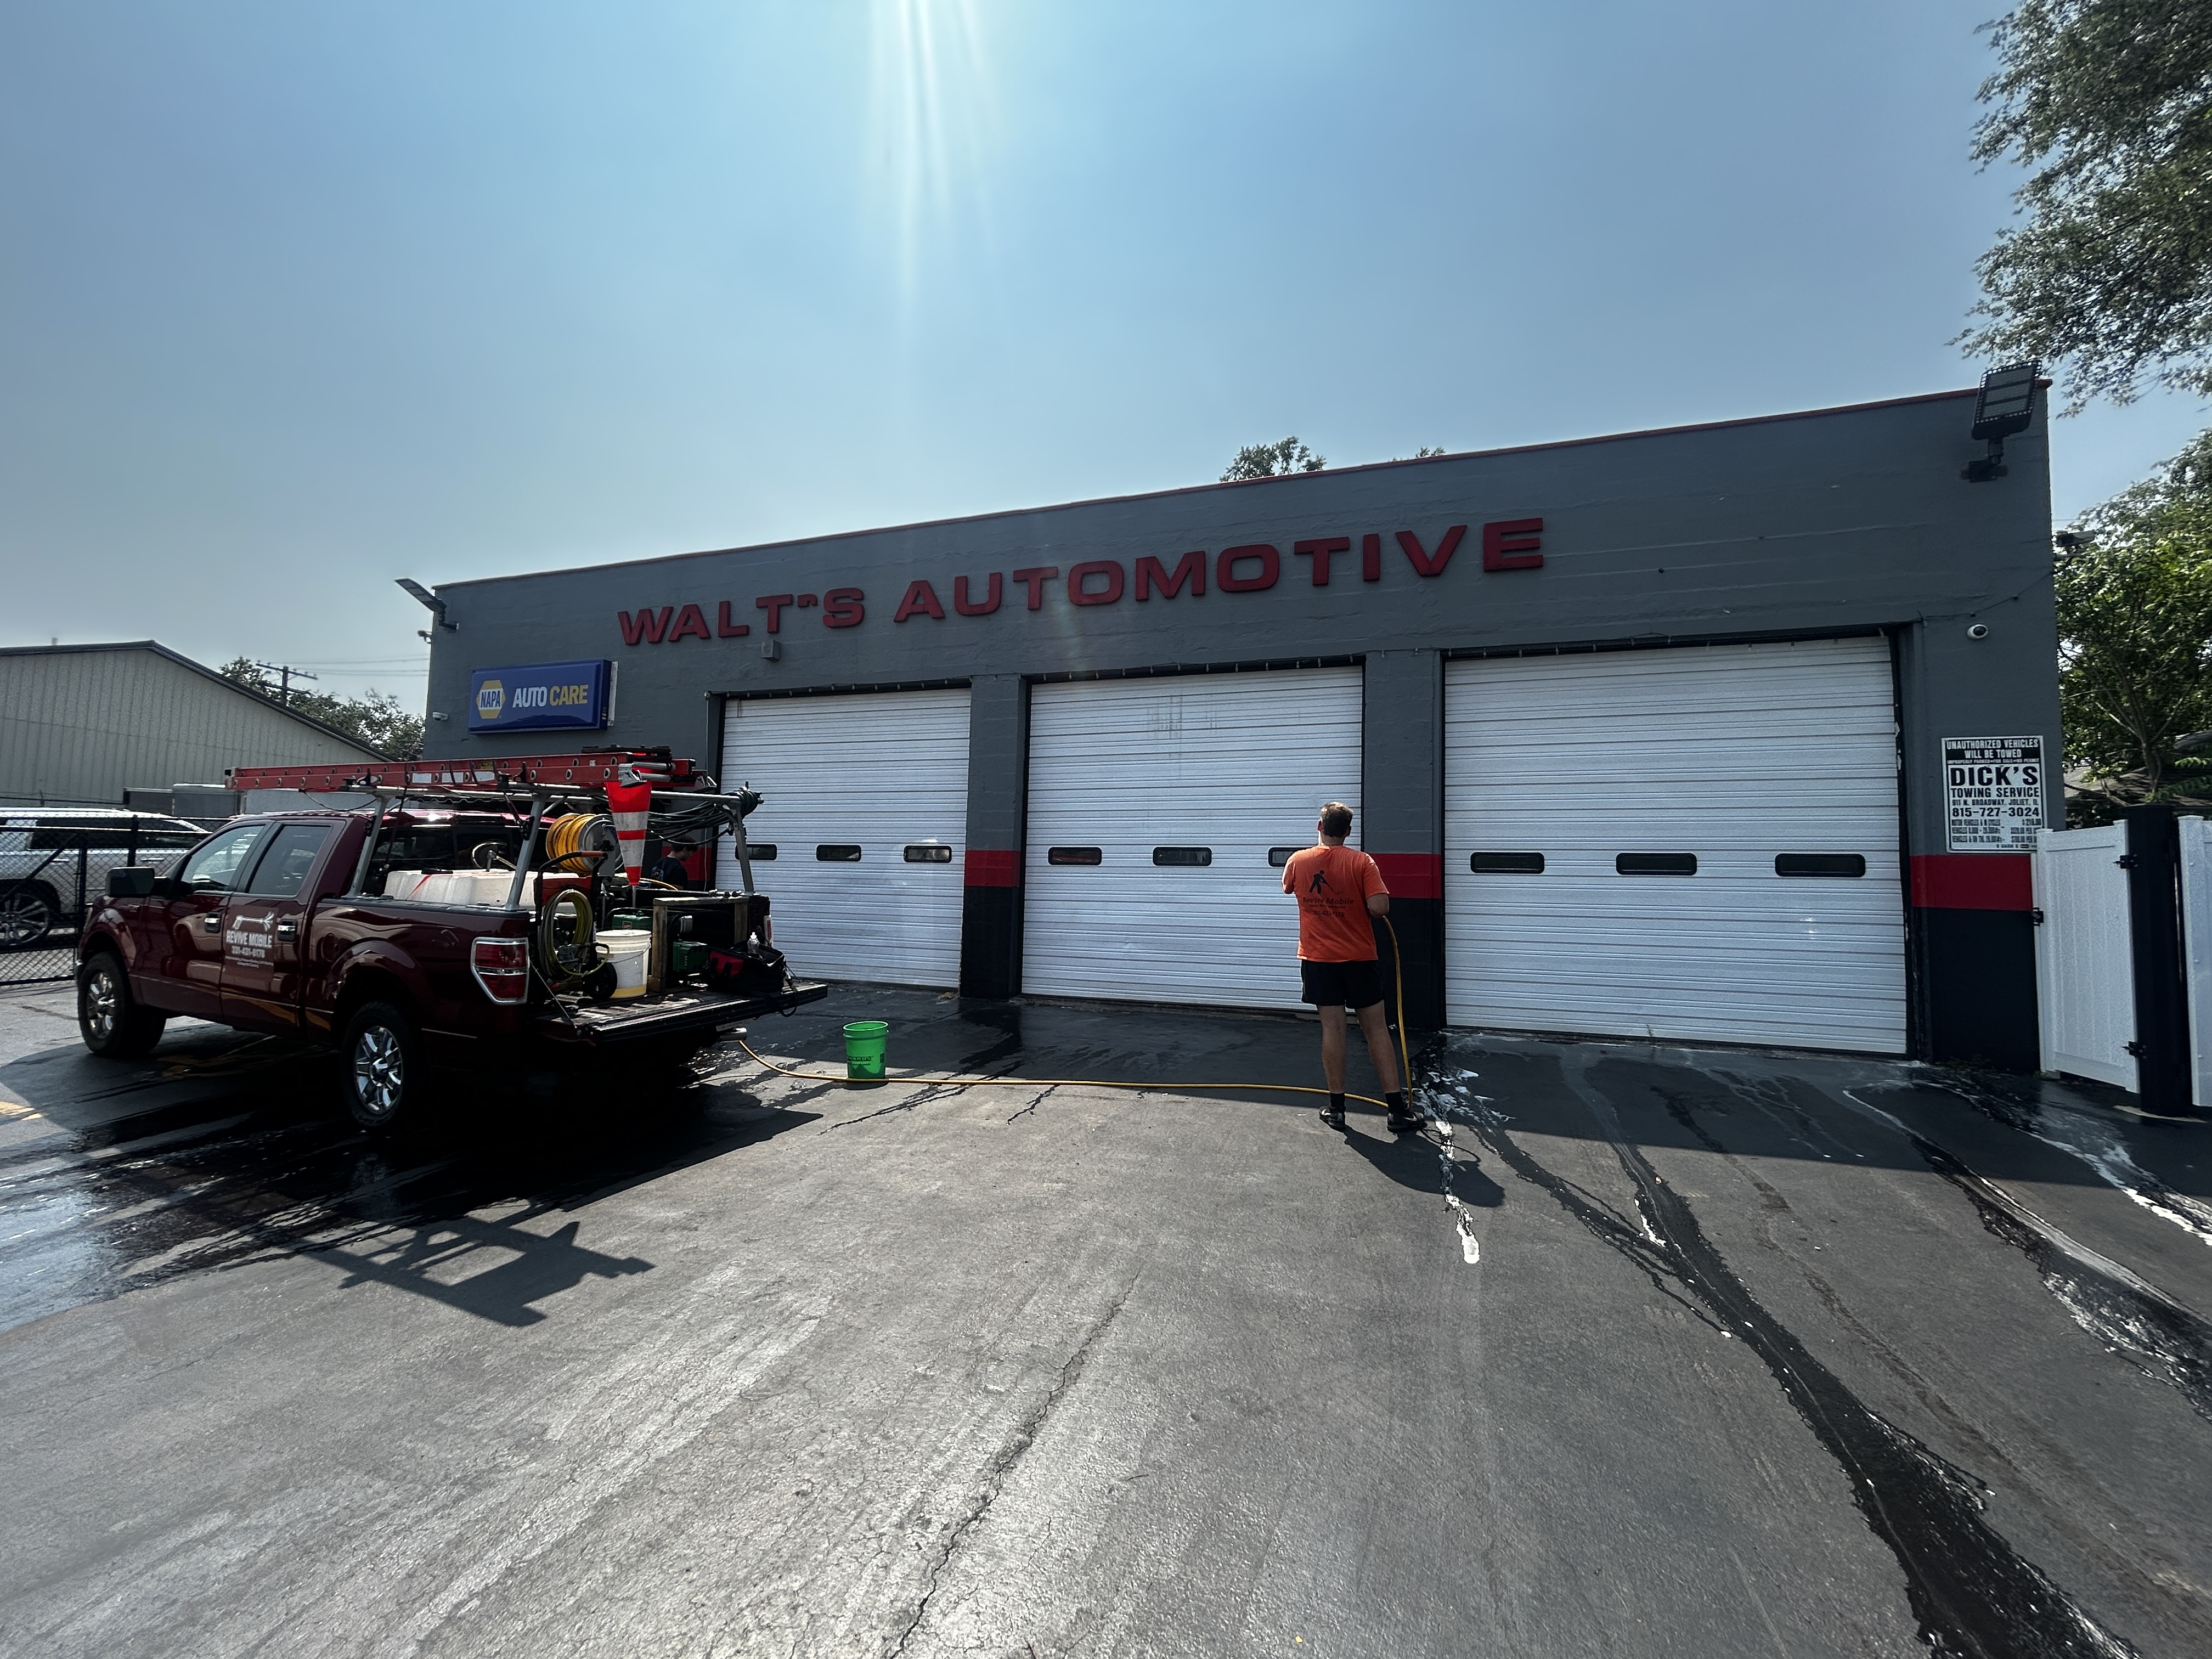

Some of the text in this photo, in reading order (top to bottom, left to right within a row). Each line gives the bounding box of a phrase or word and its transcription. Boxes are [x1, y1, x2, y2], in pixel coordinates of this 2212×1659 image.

[893, 517, 1543, 623] AUTOMOTIVE
[480, 685, 589, 708] NAPA AUTO CARE
[1946, 739, 2039, 750] UNAUTHORIZED VEHICLES
[1964, 749, 2022, 759] WILL BE TOWED
[1950, 765, 2038, 786] DICK'S
[1950, 787, 2040, 798] TOWING SERVICE
[1952, 807, 2040, 817] 815-727-3024
[226, 930, 273, 949] REVIVE MOBILE
